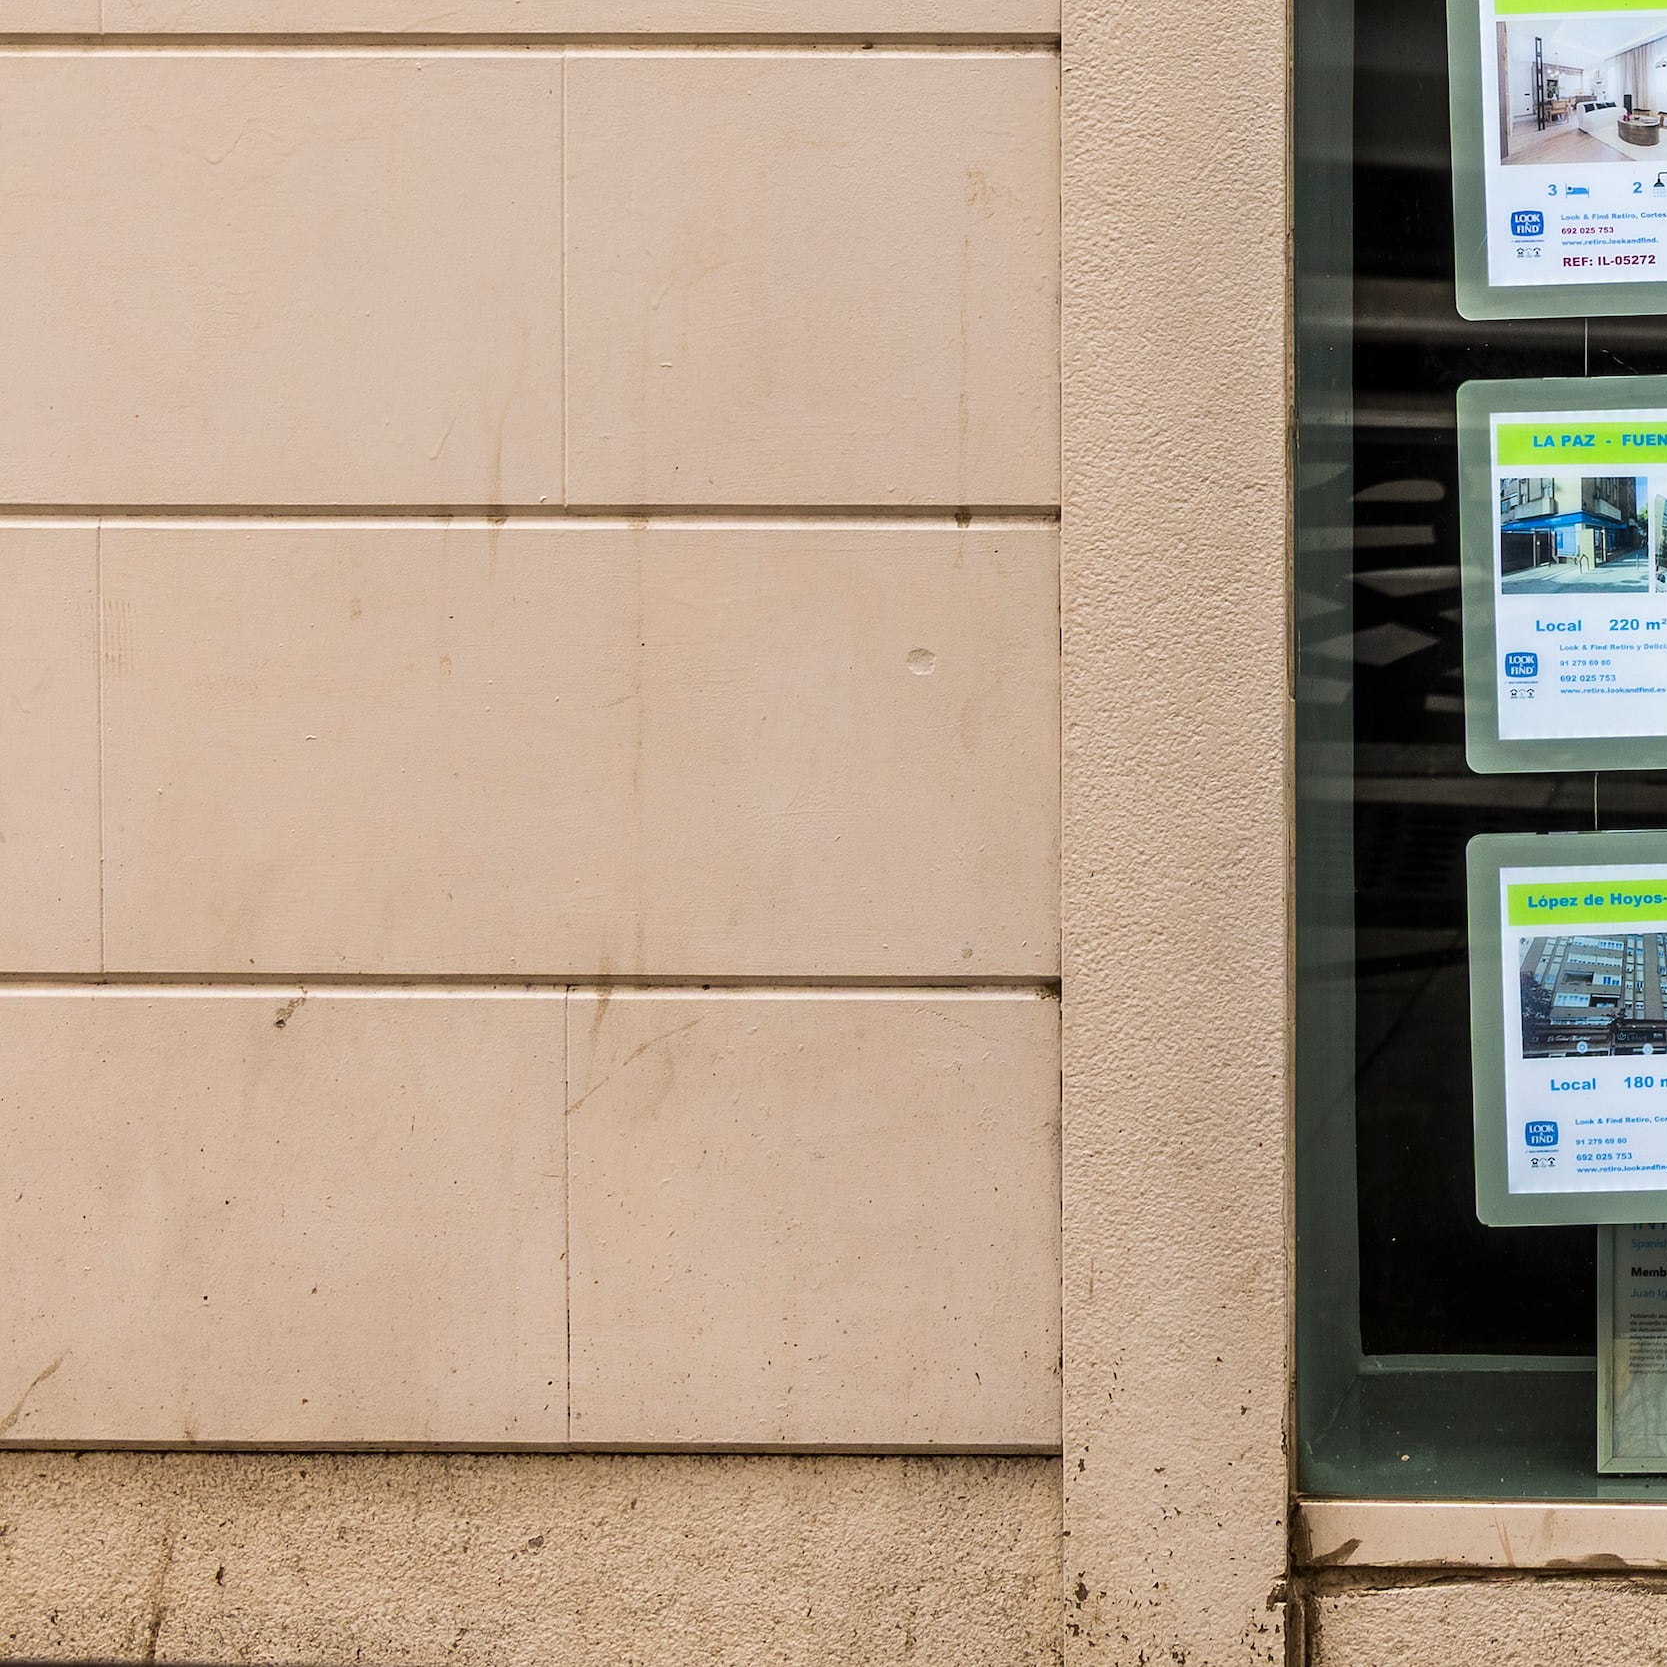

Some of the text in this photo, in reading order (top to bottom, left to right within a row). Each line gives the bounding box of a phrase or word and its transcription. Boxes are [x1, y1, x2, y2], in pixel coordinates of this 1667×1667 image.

[1562, 254, 1656, 267] REF: IL-05272
[1532, 434, 1556, 448] LA
[1560, 434, 1596, 447] PAZ
[1527, 894, 1579, 911] López
[1583, 893, 1605, 907] de
